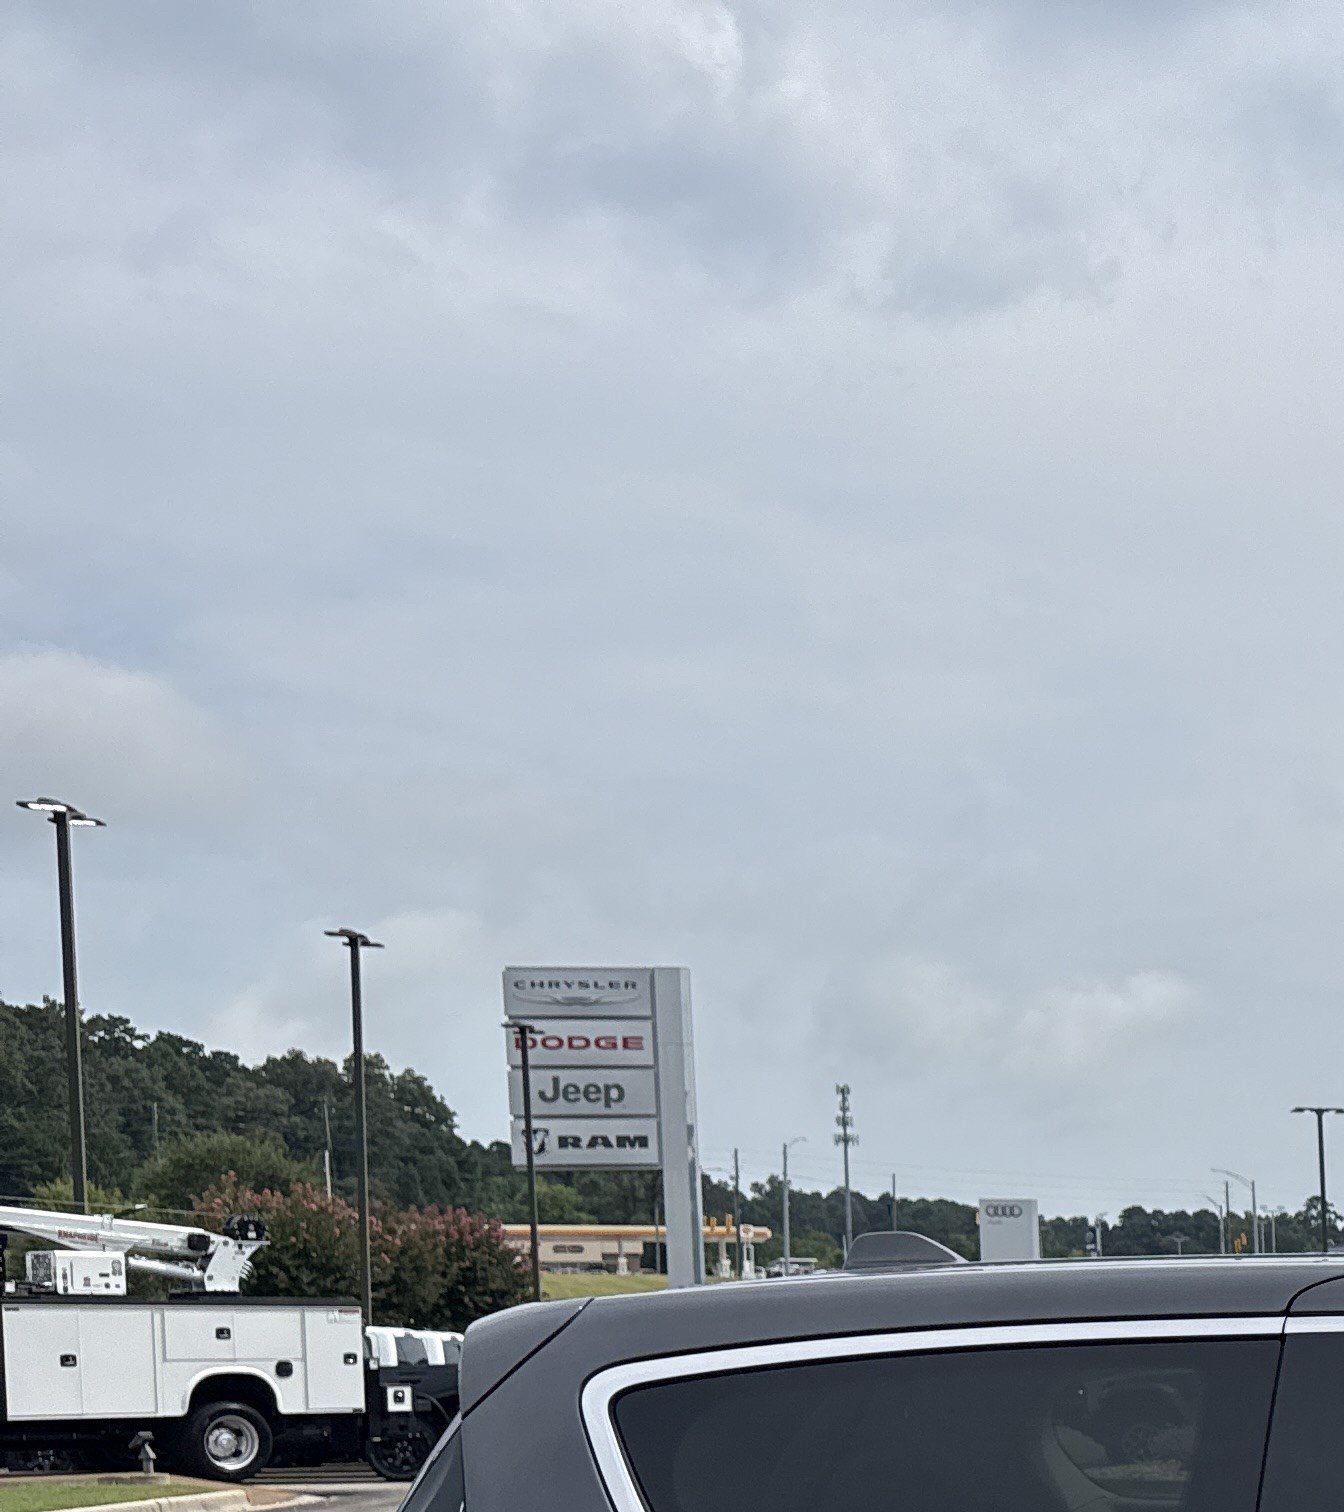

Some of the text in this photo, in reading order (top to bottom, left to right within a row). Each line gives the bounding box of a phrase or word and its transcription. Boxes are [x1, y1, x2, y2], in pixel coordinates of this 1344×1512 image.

[513, 979, 637, 990] CHRYSLER
[514, 1035, 644, 1050] DODGE
[538, 1076, 625, 1108] Jeep
[558, 1135, 649, 1149] RAM
